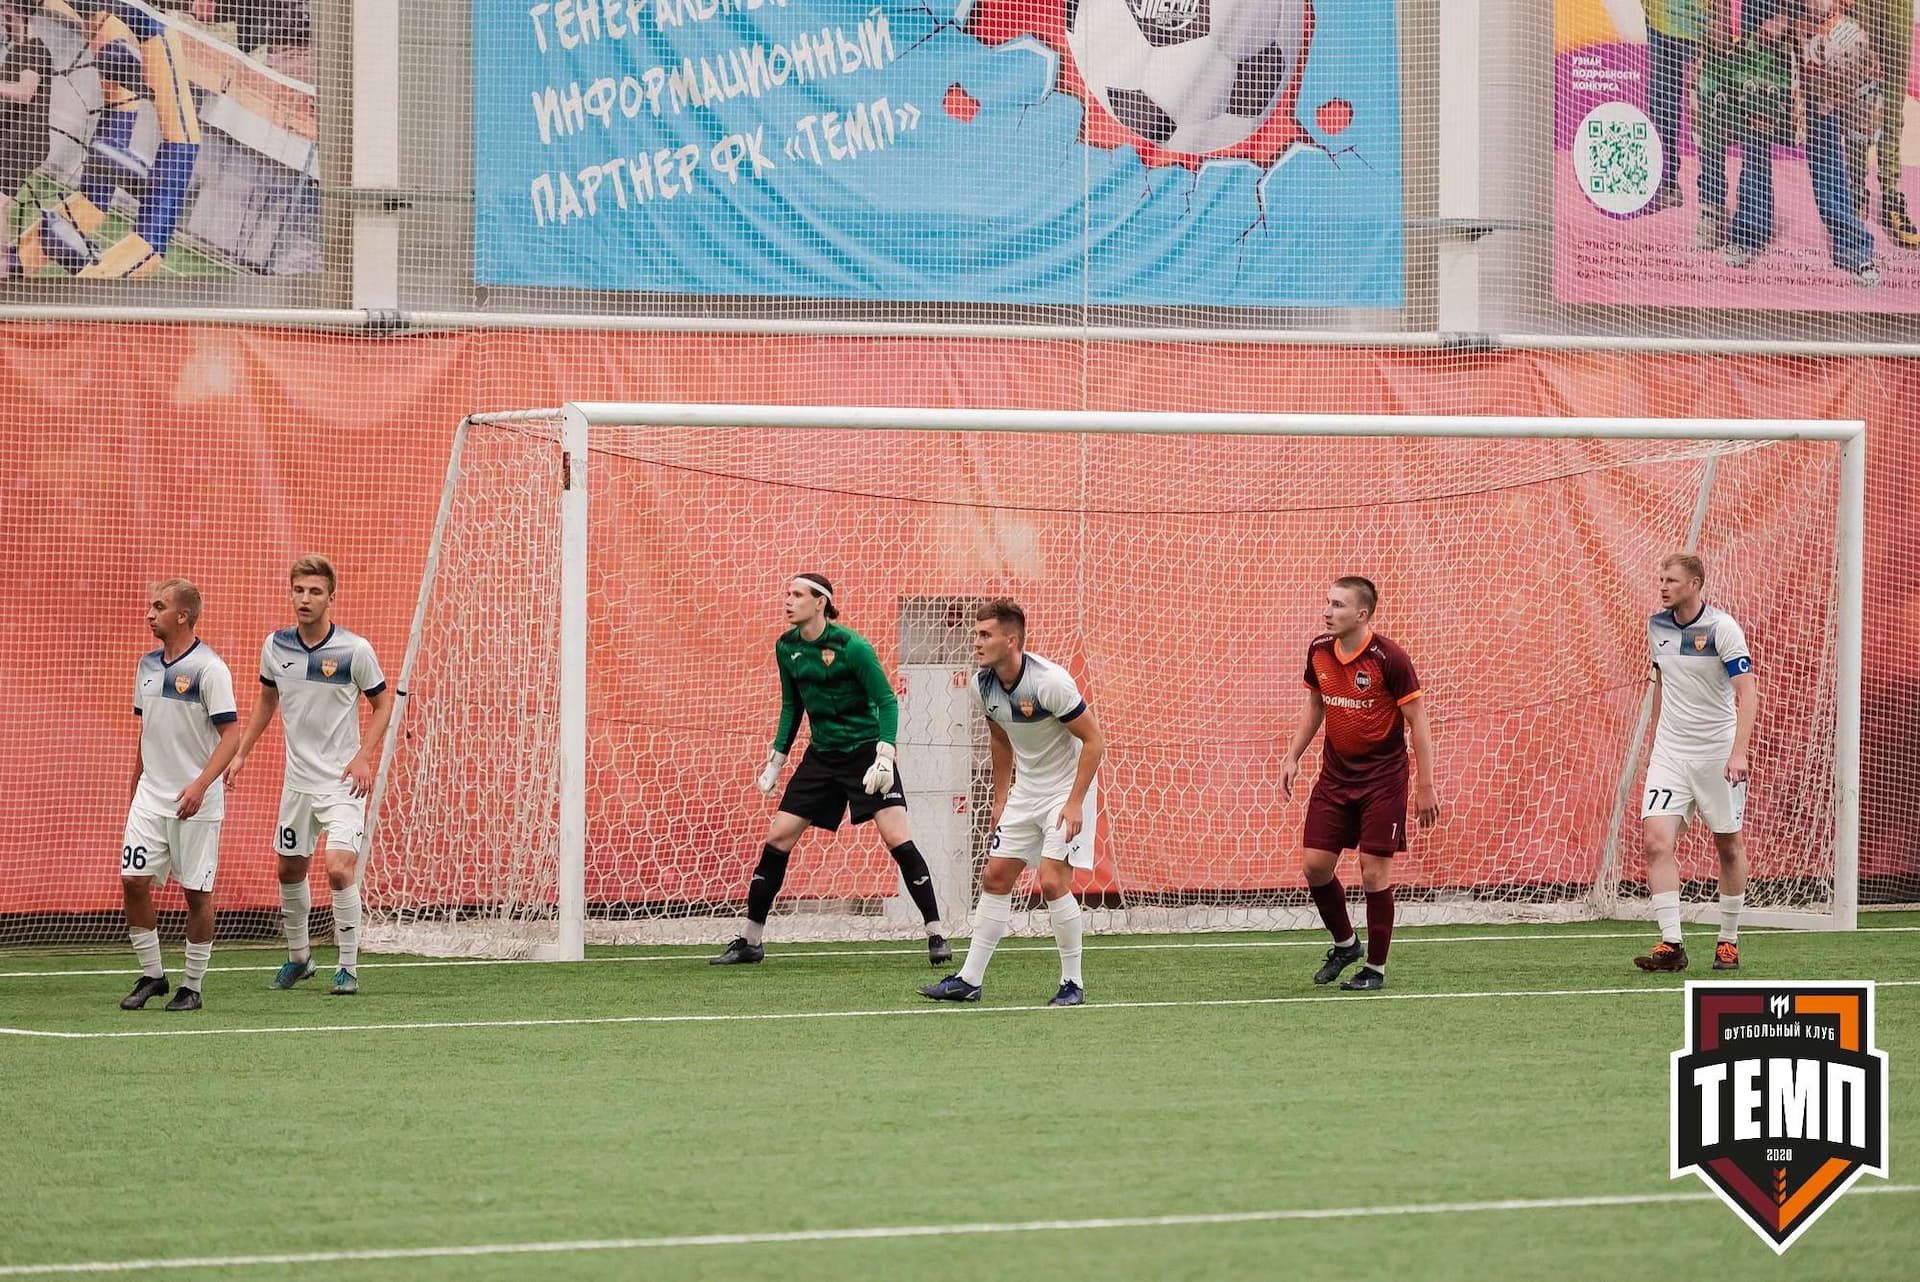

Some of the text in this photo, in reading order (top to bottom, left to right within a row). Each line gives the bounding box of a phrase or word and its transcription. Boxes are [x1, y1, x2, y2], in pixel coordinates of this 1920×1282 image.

[532, 7, 895, 145] ИНФОРМАЦИОННЫЙ
[1573, 81, 1621, 92] КОНКУРСА
[531, 97, 921, 227] ПАРТНЕР ФК «ТЕМП»
[1738, 658, 1750, 673] C
[1648, 789, 1673, 811] 77
[280, 826, 297, 849] 19
[122, 845, 148, 870] 96
